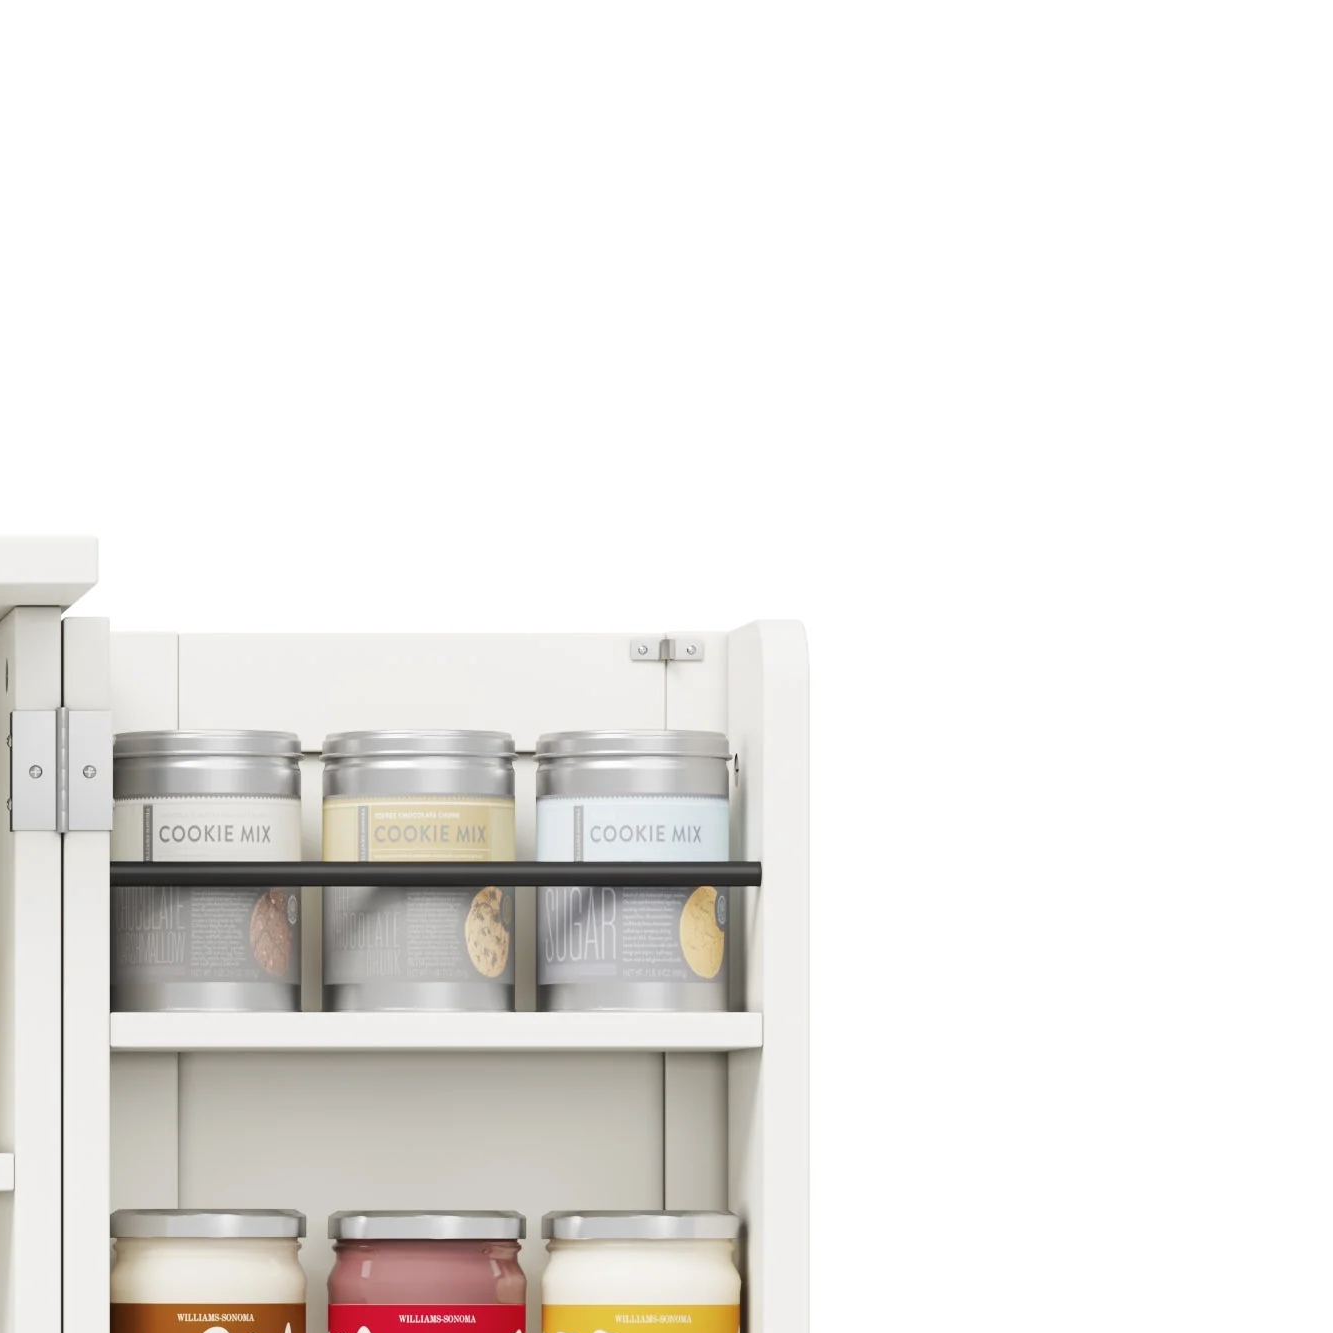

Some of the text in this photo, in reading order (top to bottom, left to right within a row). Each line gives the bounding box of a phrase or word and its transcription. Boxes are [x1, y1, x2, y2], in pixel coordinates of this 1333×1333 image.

[159, 825, 271, 843] COOKIE MIX
[374, 825, 486, 843] COOKIE MIX
[589, 825, 703, 843] COOKIE MIX
[177, 1313, 254, 1322] WILLIAMS-SONOMA
[399, 1314, 476, 1323] WILLIAMS-SONOMA
[615, 1314, 692, 1323] WILLIAMS-SONOMA
